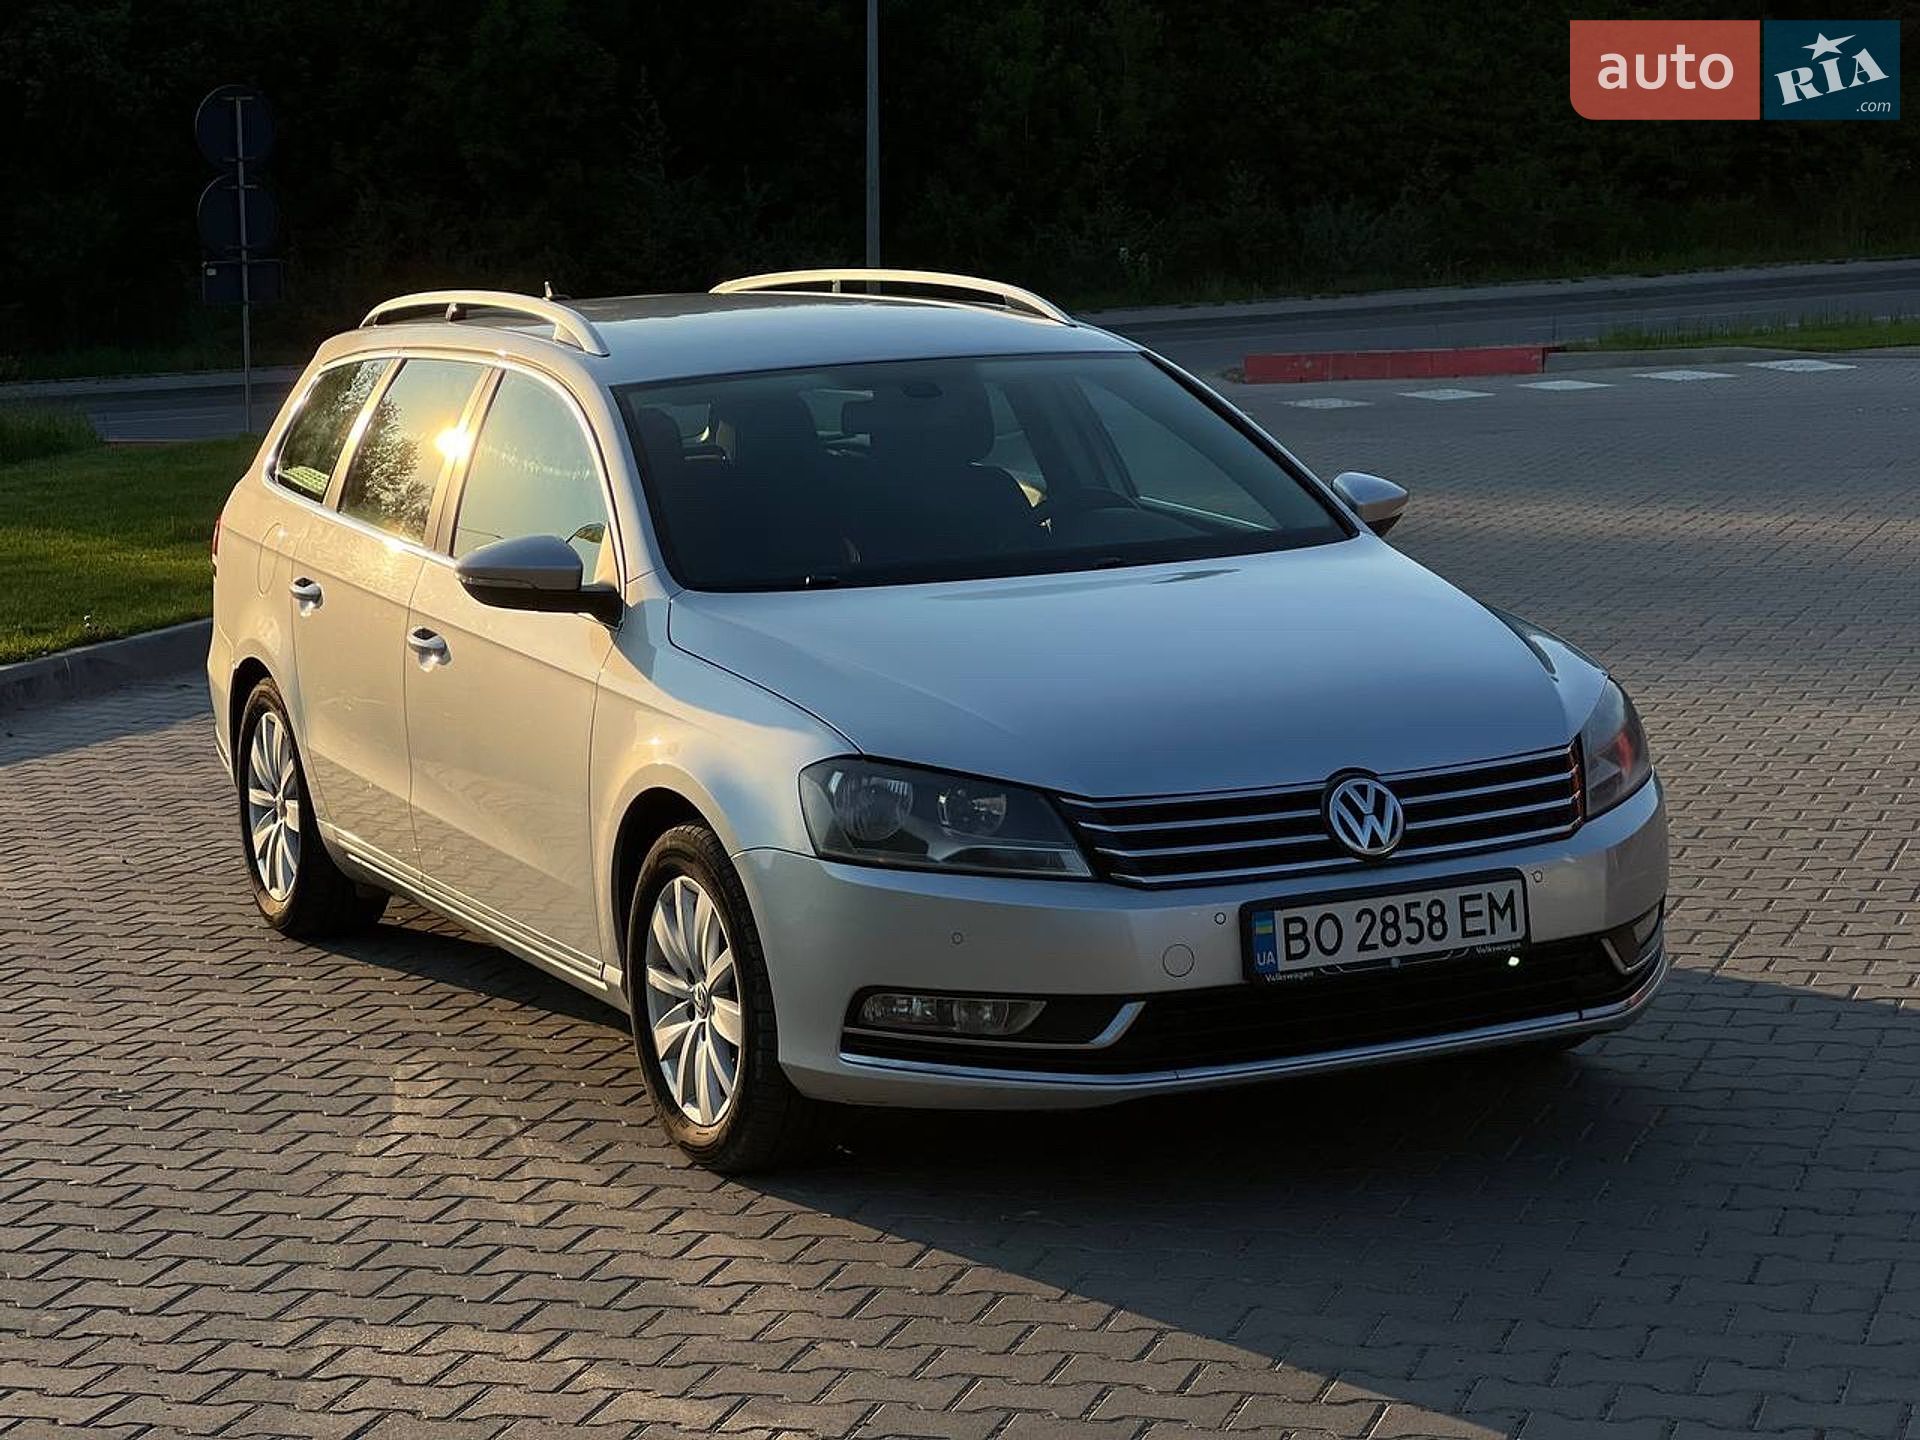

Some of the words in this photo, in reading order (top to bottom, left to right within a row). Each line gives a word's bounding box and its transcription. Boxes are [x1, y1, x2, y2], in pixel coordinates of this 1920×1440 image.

[1331, 779, 1402, 853] VW
[1256, 951, 1276, 966] UA
[1283, 913, 1344, 961] BO
[1356, 899, 1449, 953] 2858
[1459, 889, 1517, 938] EM
